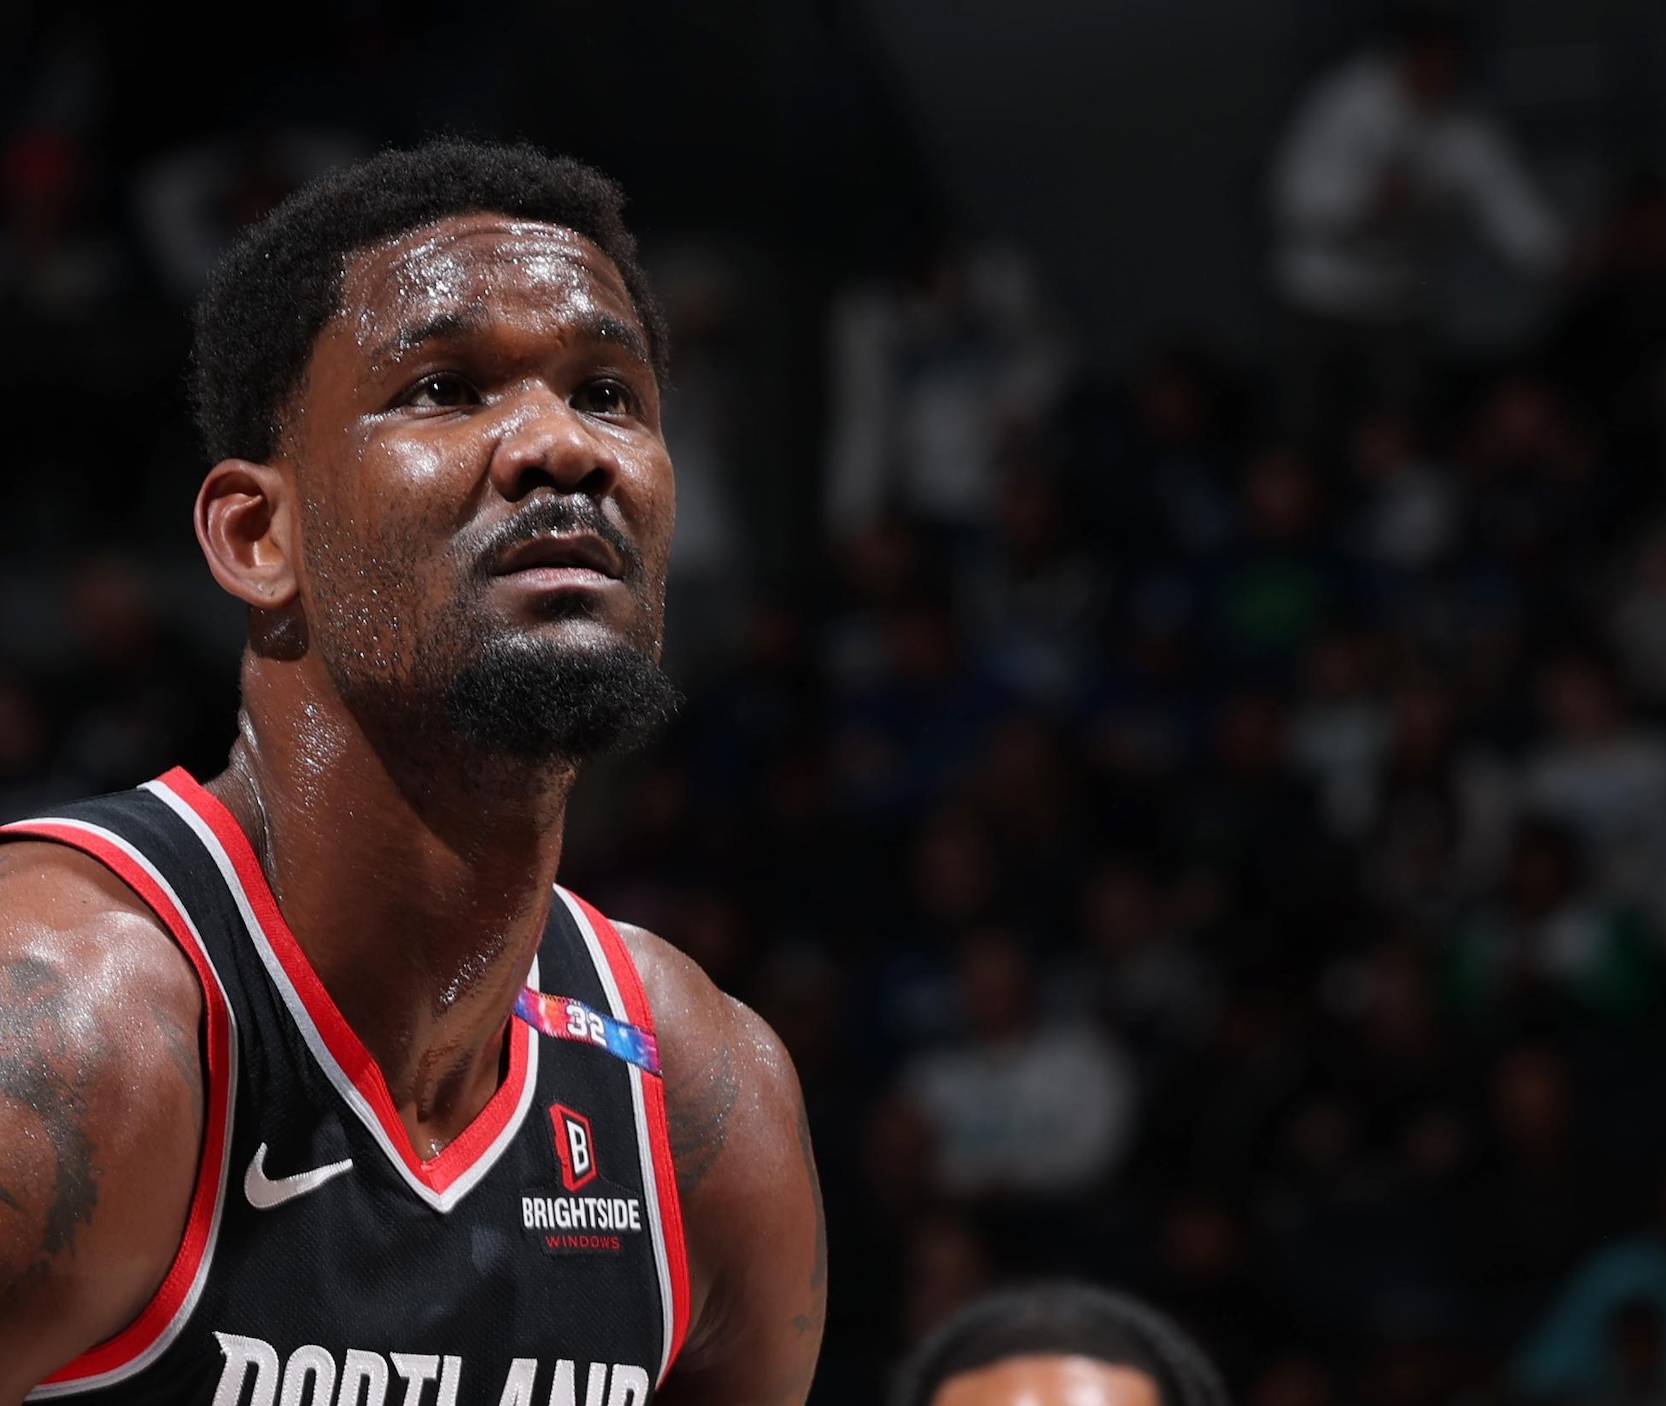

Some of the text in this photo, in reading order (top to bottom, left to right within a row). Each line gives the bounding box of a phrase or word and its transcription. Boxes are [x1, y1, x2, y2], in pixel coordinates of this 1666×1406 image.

[566, 1004, 606, 1046] 32
[566, 1119, 589, 1173] B
[521, 1197, 641, 1230] BRIGHTSIDE
[545, 1235, 621, 1249] WINDOWS
